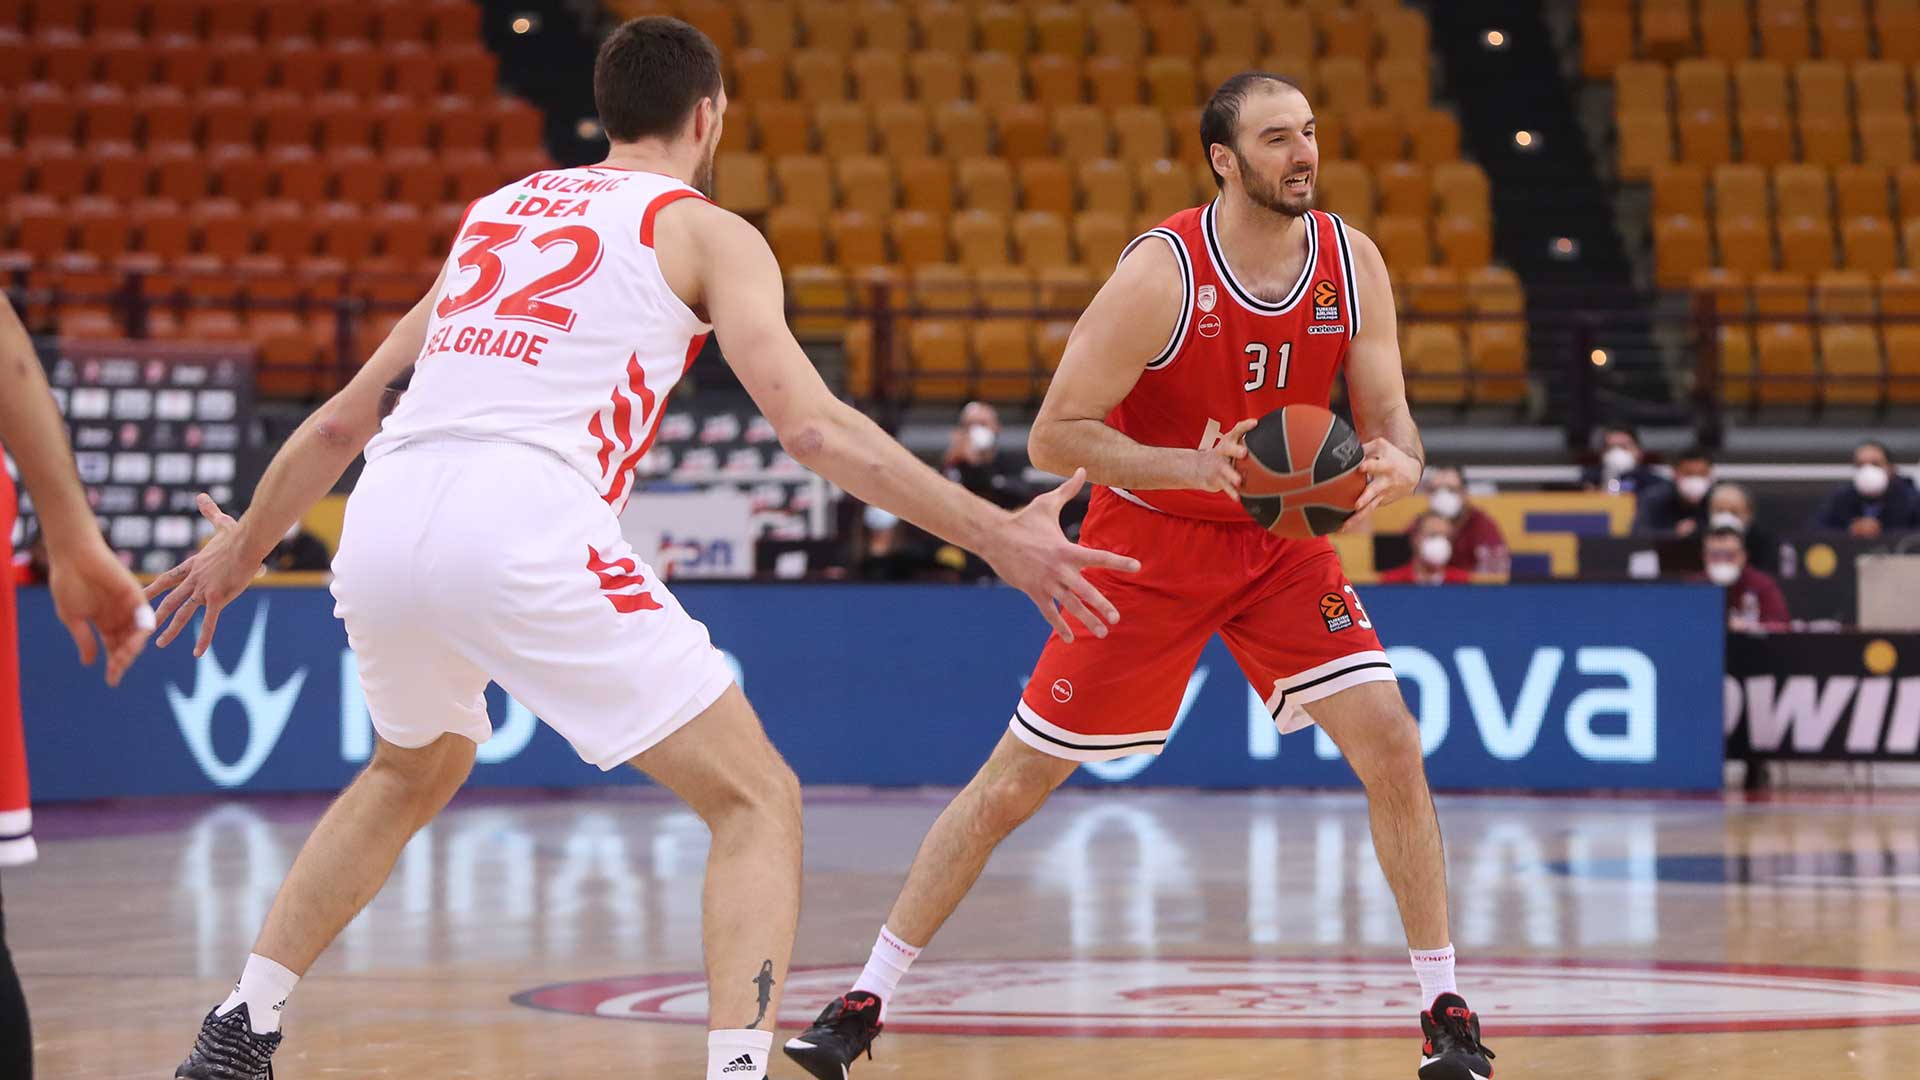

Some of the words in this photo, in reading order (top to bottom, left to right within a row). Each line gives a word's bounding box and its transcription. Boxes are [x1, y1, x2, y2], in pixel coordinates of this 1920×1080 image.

[436, 221, 604, 333] 32
[1244, 342, 1292, 392] 31
[722, 1063, 757, 1073] adidas
